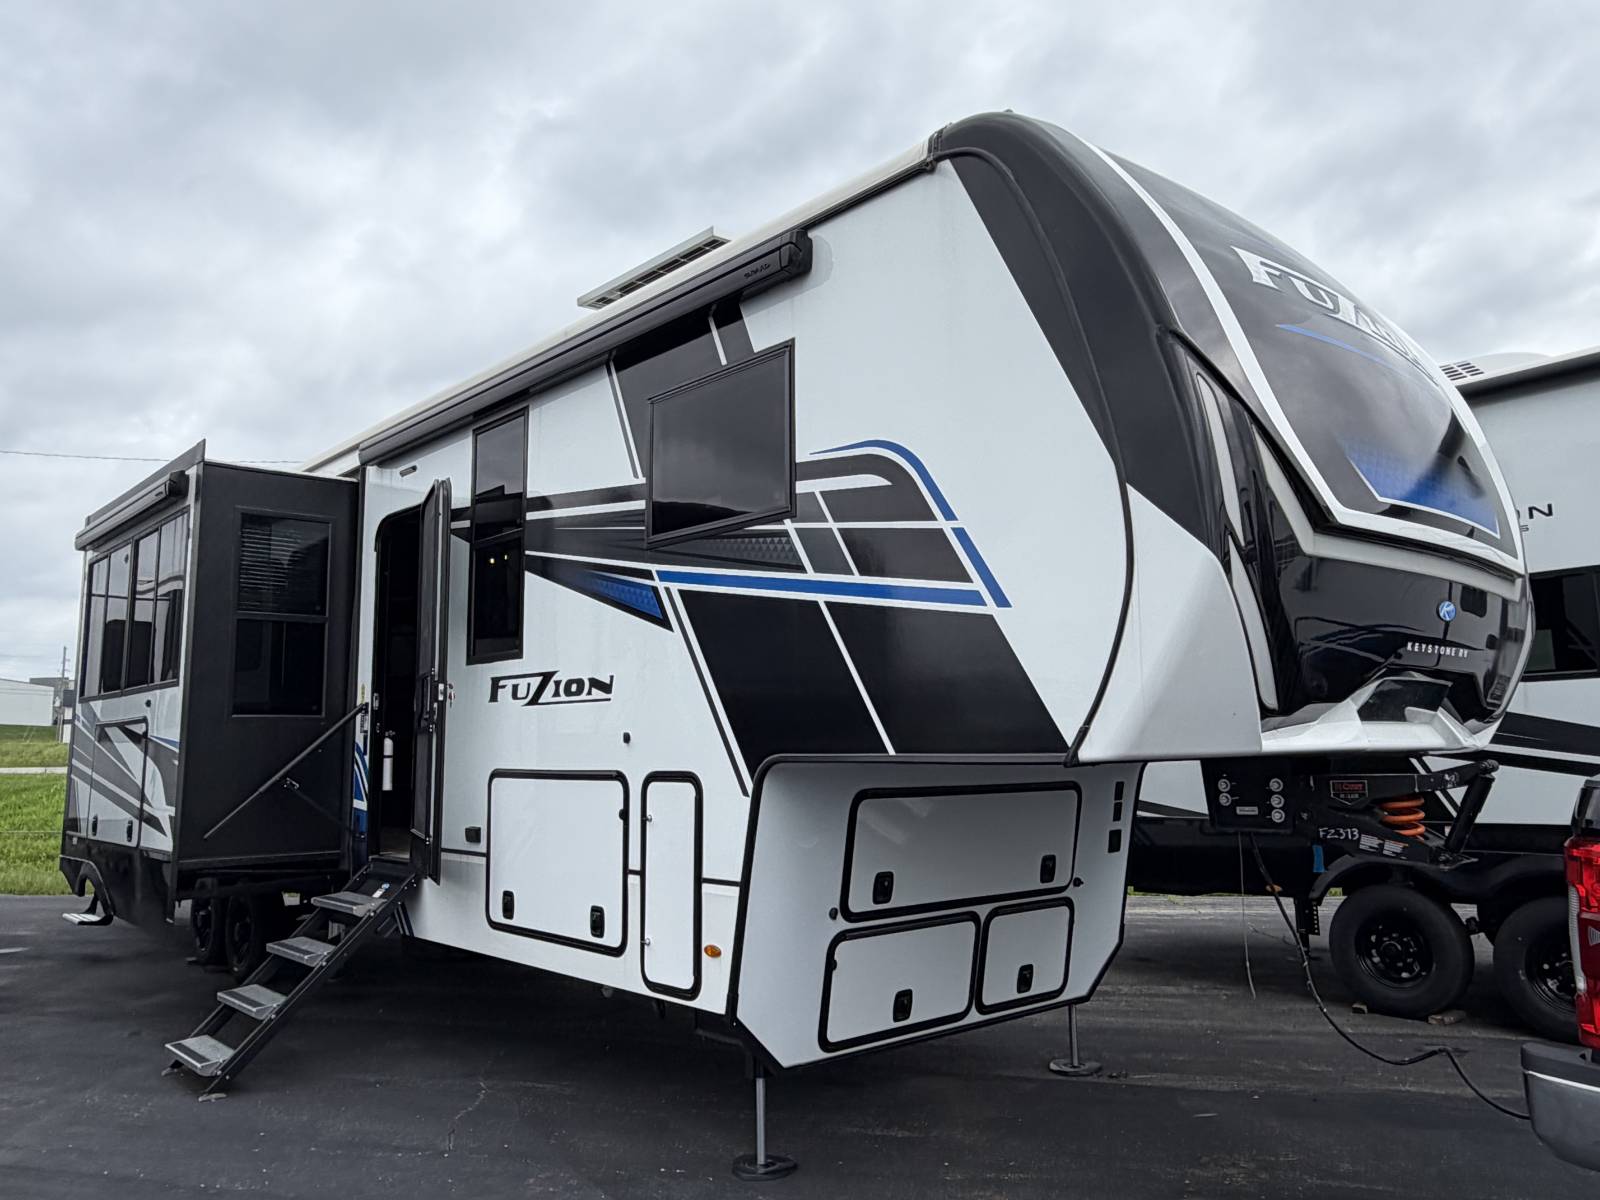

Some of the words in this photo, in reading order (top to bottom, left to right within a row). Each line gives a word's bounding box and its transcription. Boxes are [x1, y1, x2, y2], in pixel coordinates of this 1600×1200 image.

[1406, 641, 1456, 656] KEYSTONE
[1458, 649, 1469, 658] RV
[488, 670, 614, 707] FUZION
